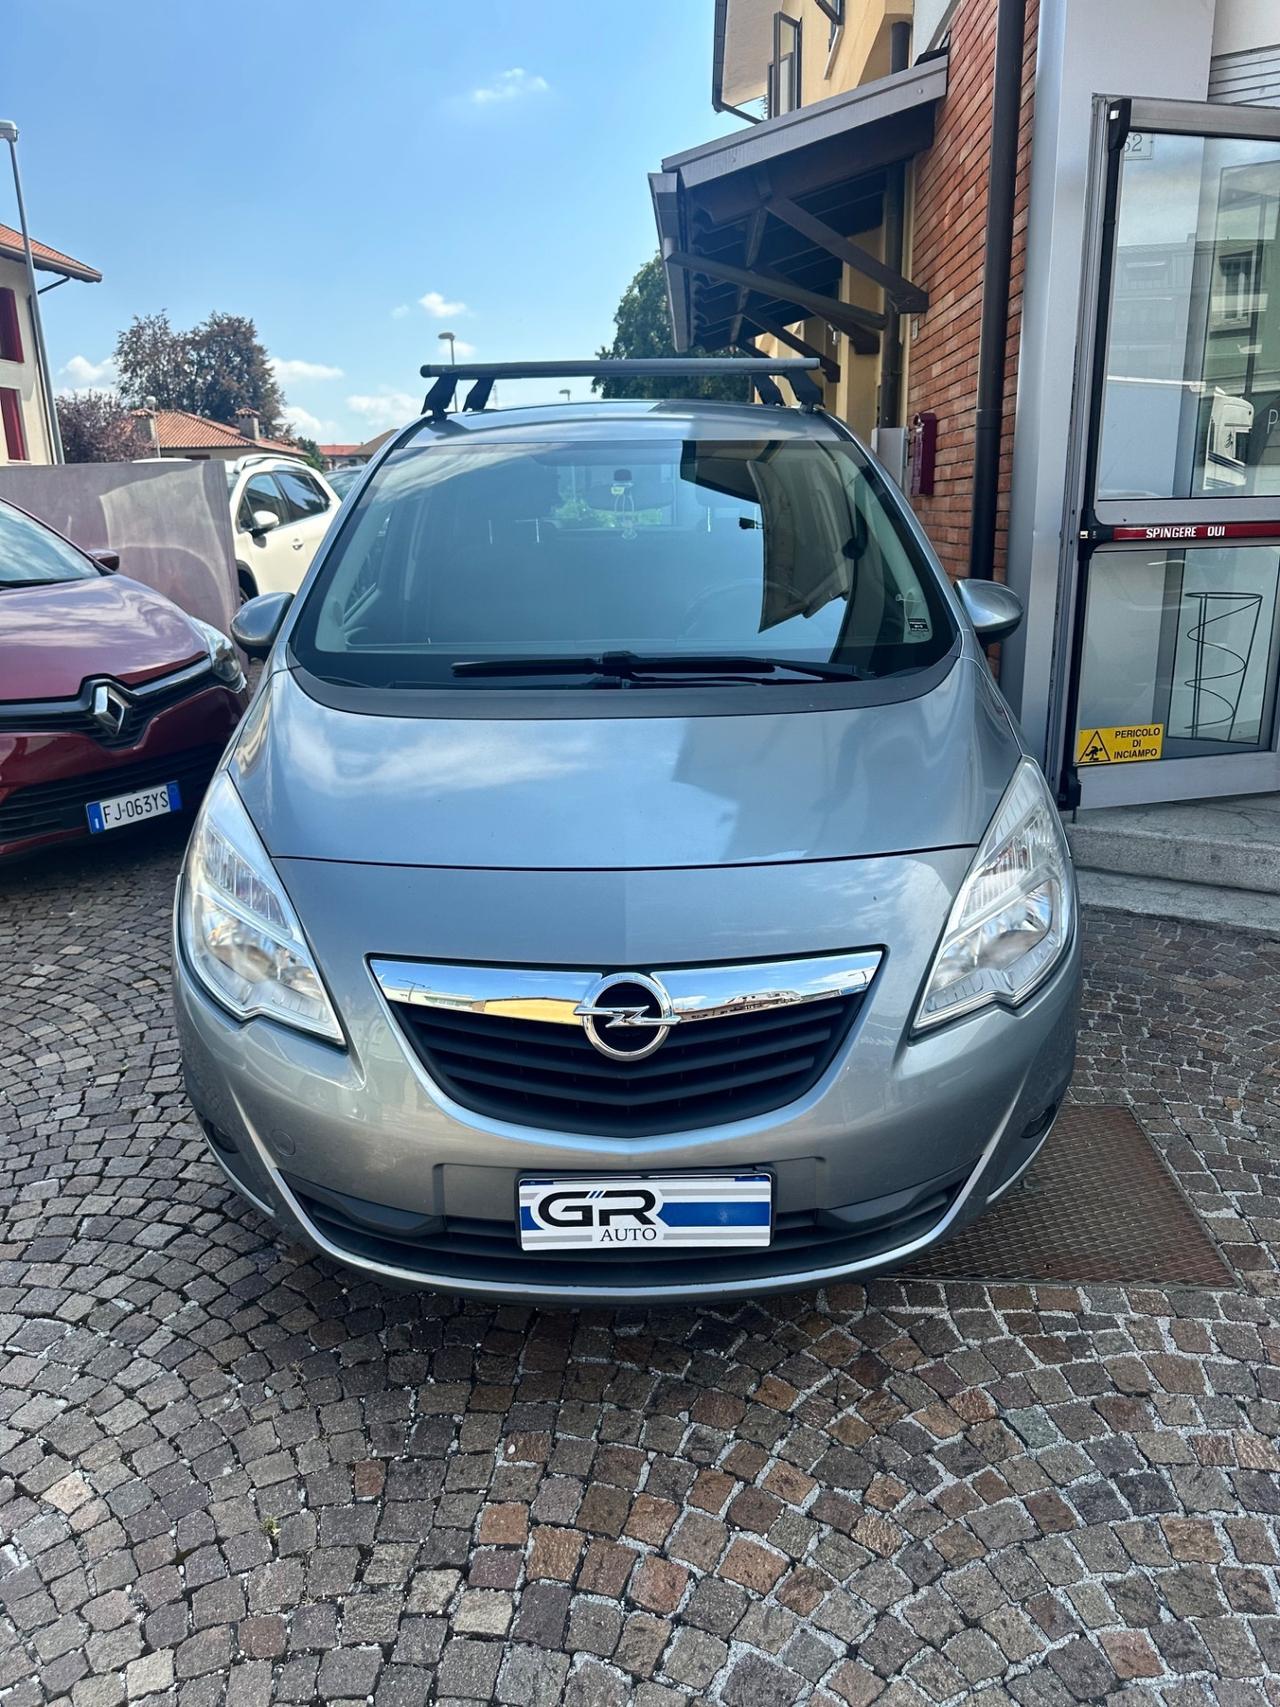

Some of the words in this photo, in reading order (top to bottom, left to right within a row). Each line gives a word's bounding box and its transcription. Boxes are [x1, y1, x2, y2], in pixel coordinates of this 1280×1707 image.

[1146, 526, 1197, 539] SPINGERE
[1114, 727, 1161, 739] PERICOLO
[1132, 739, 1141, 748] DI
[1113, 748, 1158, 760] INCIAMPO
[538, 1188, 657, 1228] GR
[600, 1227, 657, 1243] AUTO
